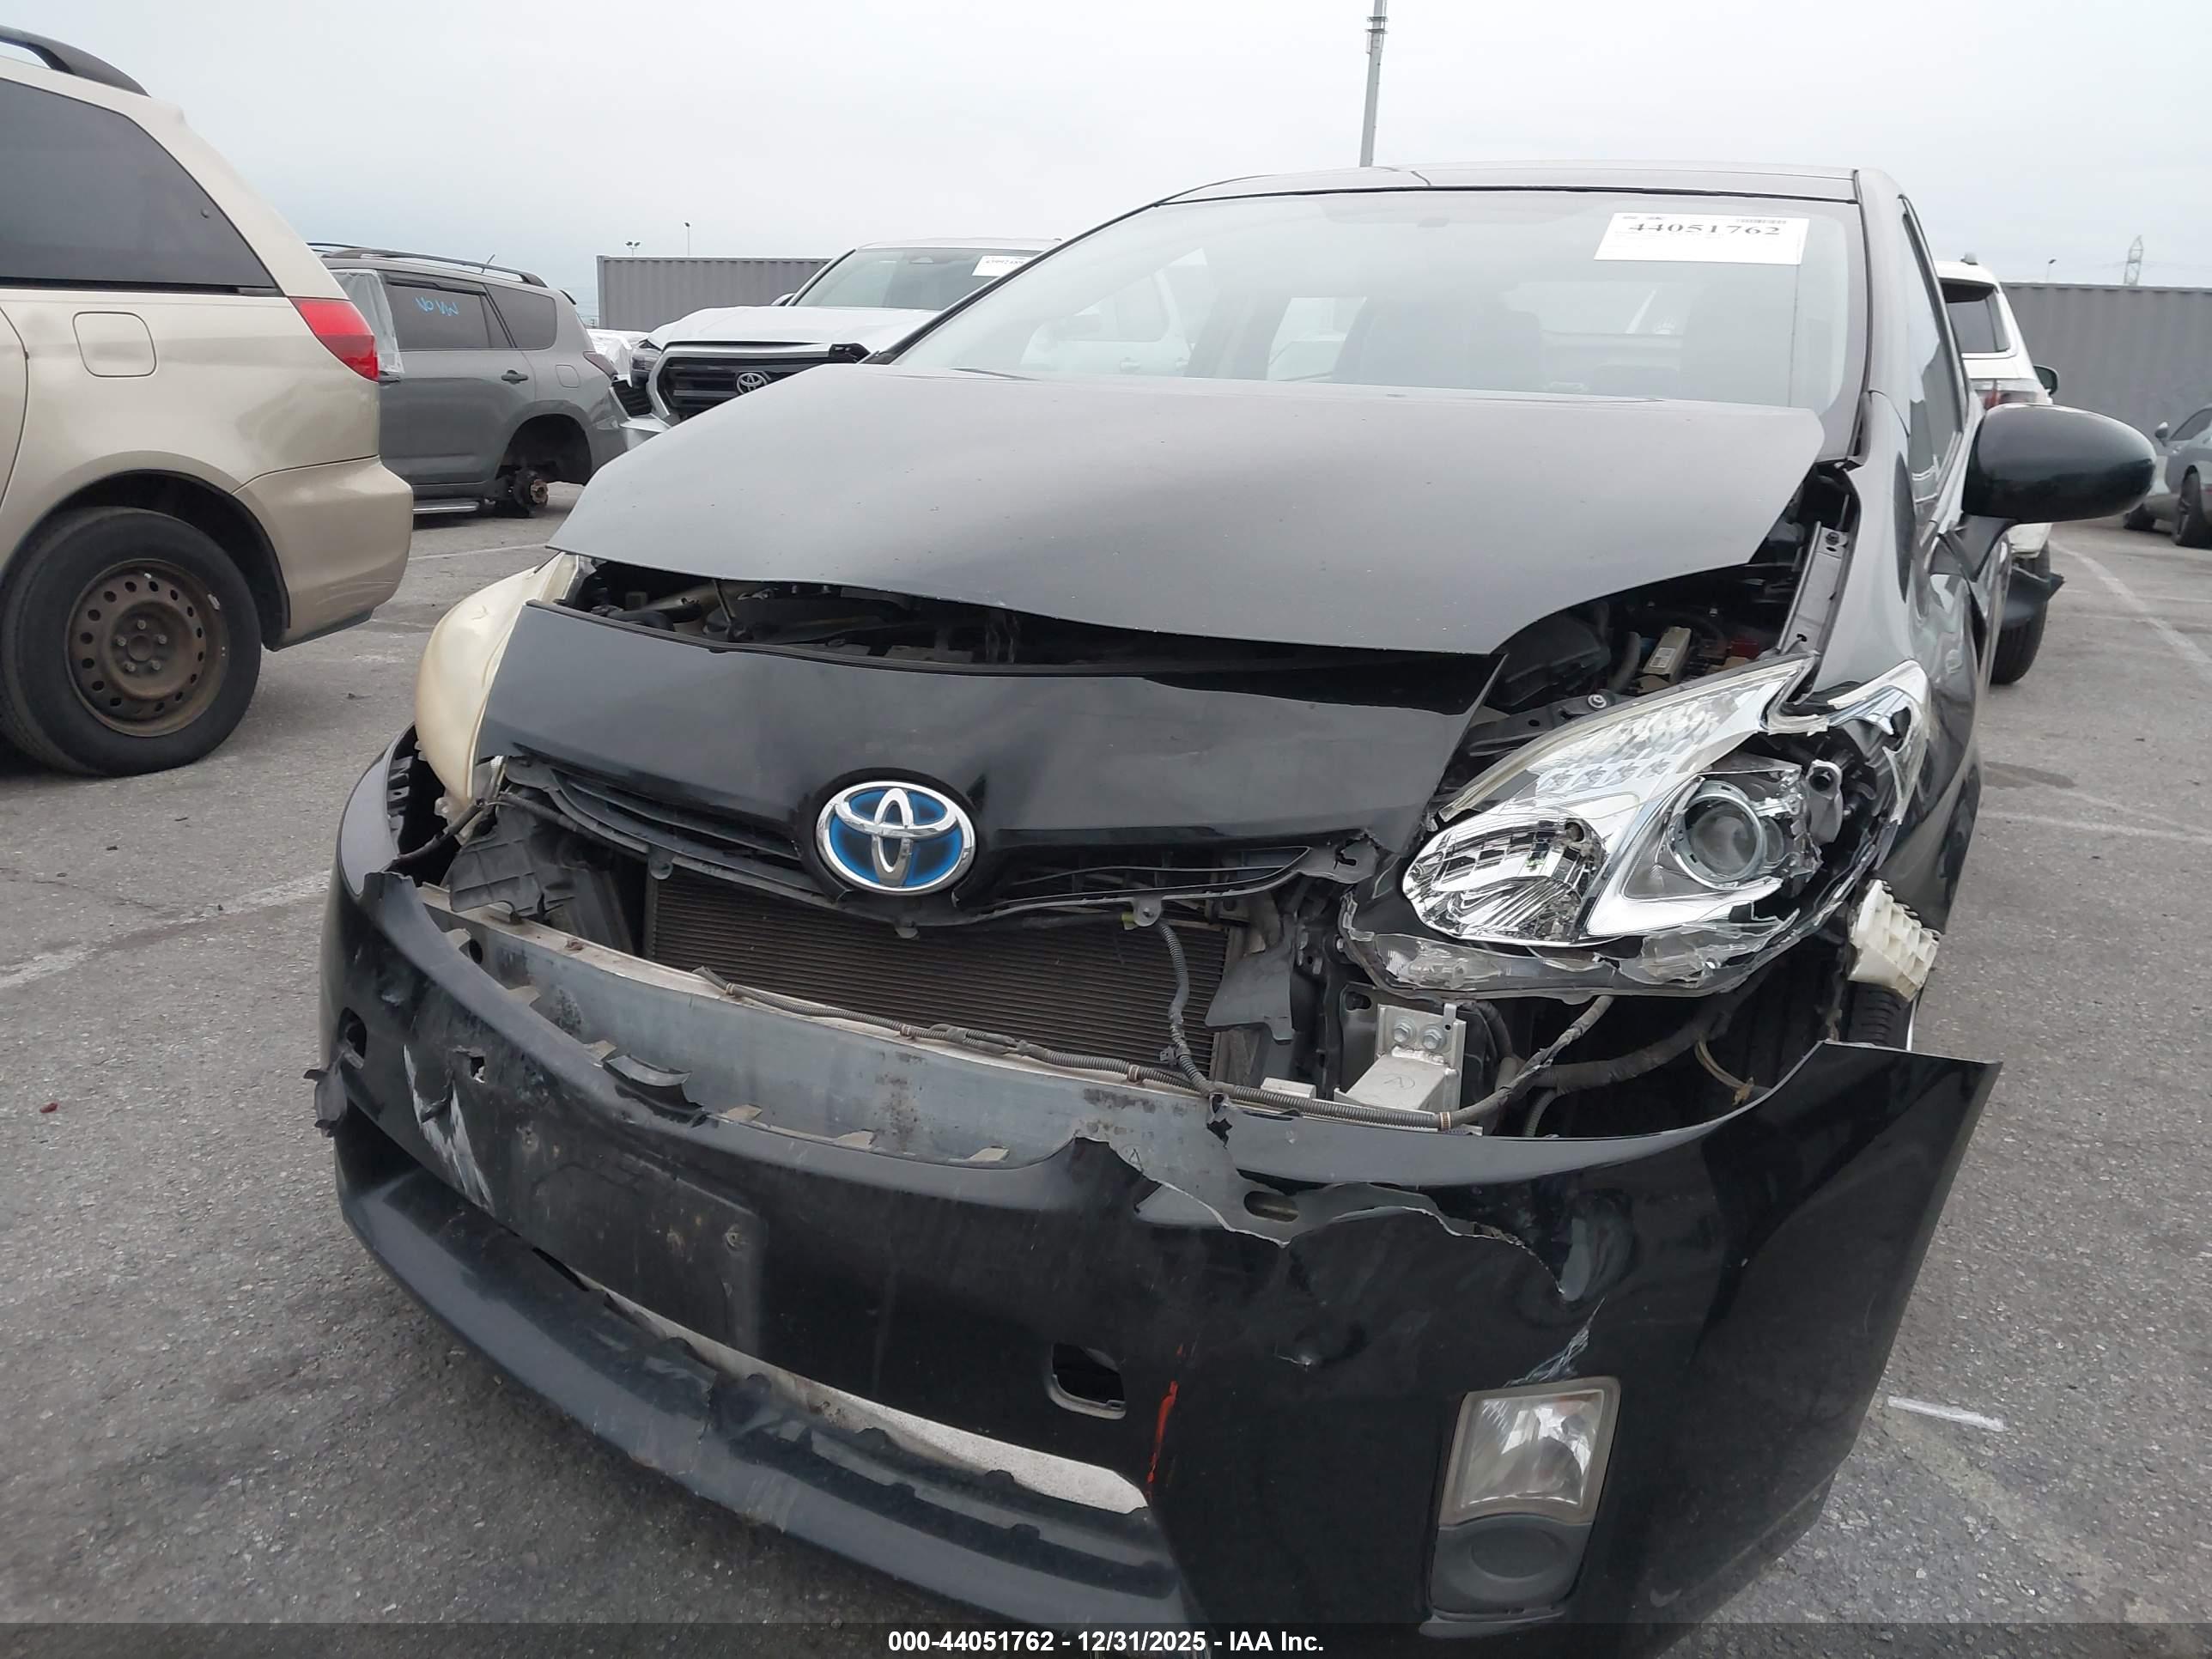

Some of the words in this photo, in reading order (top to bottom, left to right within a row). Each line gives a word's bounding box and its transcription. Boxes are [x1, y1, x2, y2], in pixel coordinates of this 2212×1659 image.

[1627, 222, 1782, 236] 44051762
[415, 296, 434, 312] NO
[434, 299, 459, 317] VIN
